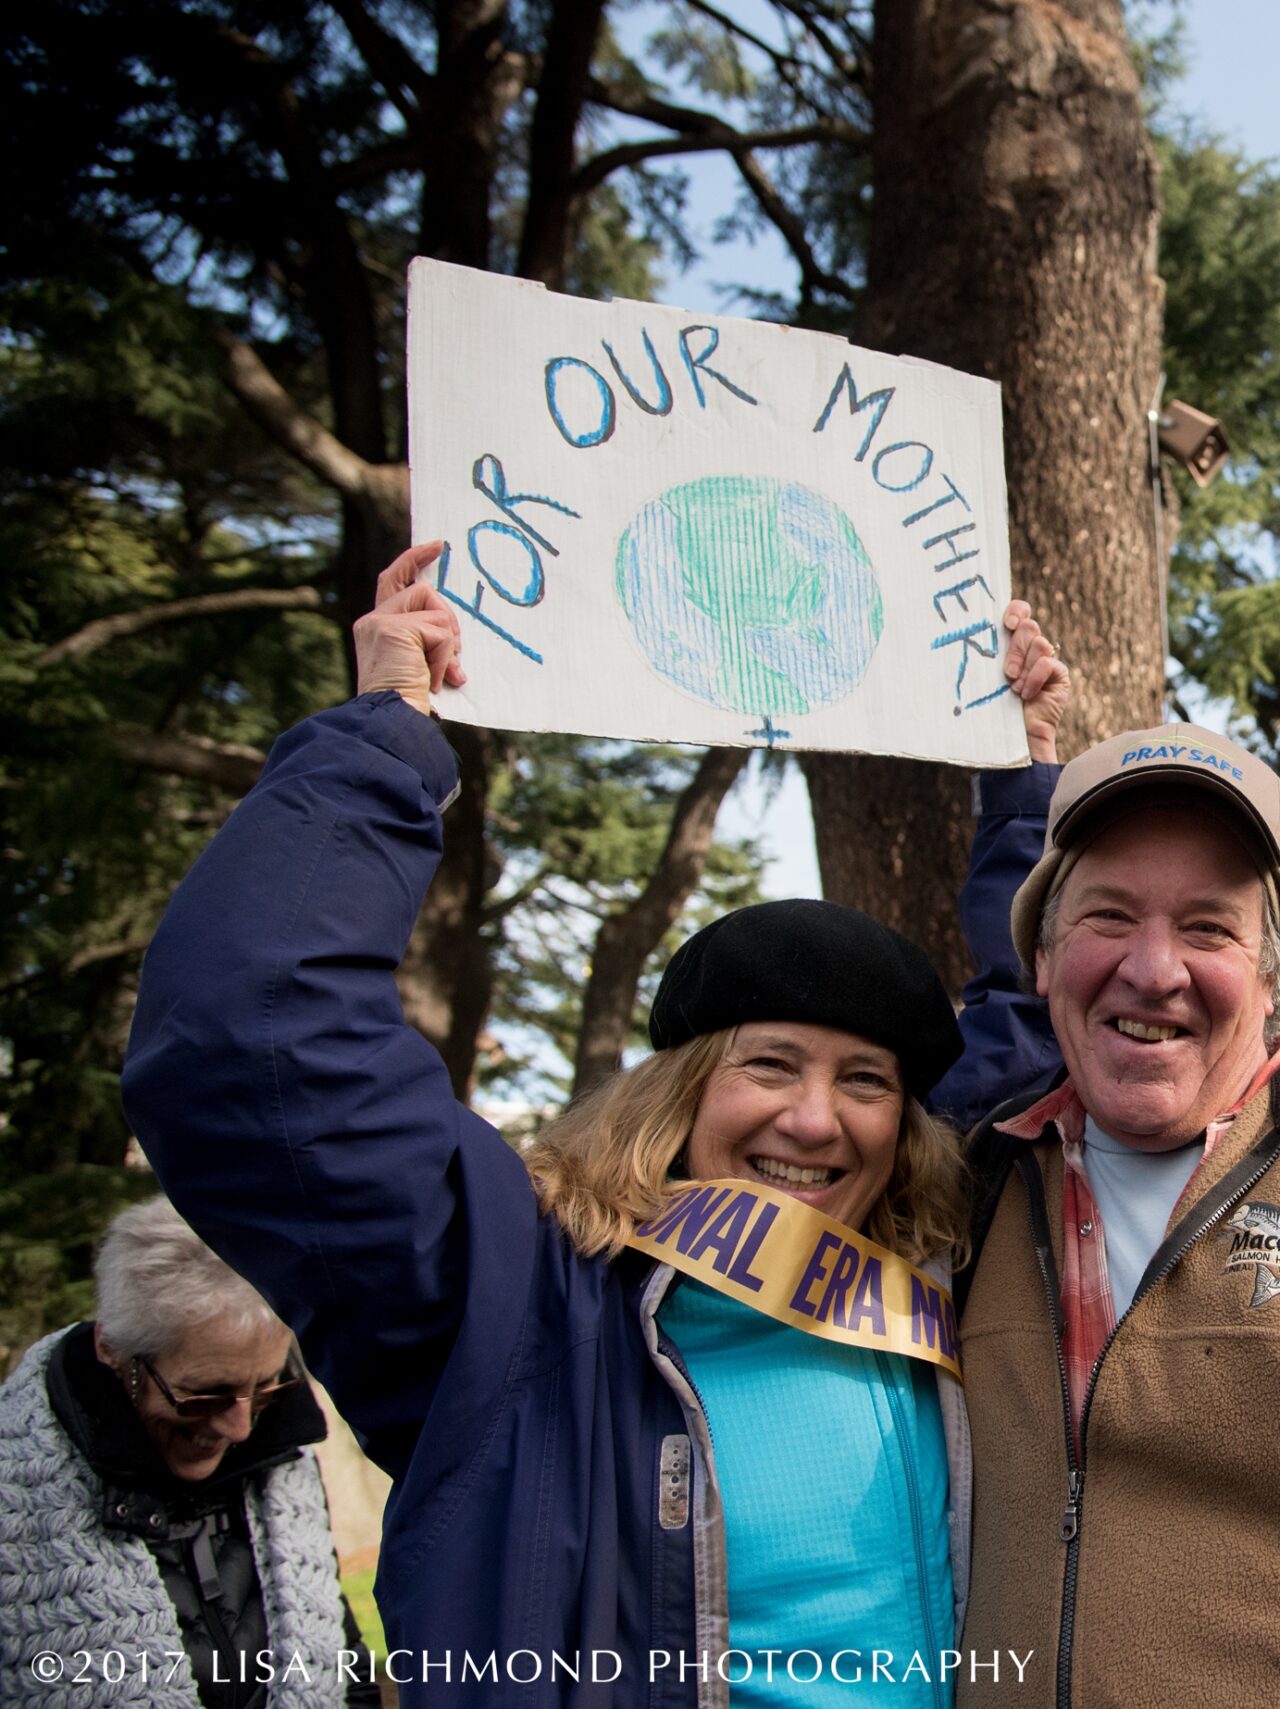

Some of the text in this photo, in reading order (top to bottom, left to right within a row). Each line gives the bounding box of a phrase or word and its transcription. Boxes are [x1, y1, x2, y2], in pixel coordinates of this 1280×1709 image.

[437, 325, 1011, 716] FOR OUR MOTHER!
[1121, 745, 1243, 781] PRAY SAFE
[789, 1230, 887, 1336] ERA
[1232, 1251, 1270, 1262] SALMON
